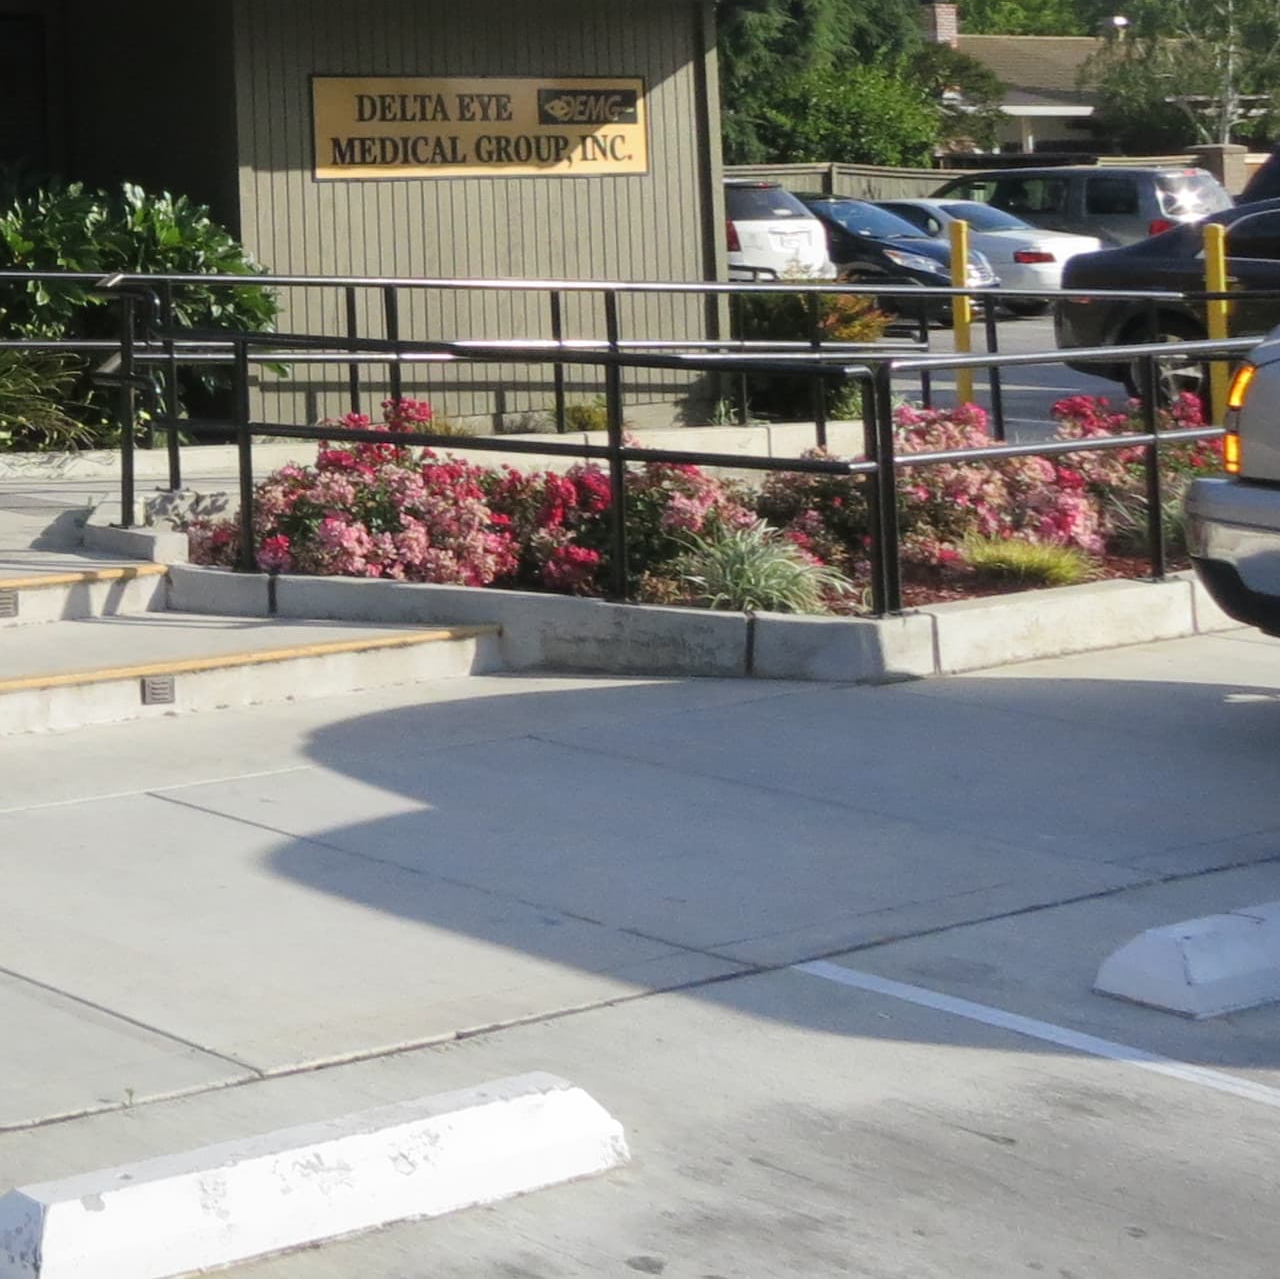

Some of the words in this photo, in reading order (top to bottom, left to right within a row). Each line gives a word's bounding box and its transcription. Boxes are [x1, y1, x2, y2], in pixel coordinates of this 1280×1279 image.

[354, 94, 451, 123] DELTA
[456, 94, 513, 122] EYE
[330, 135, 467, 165] MEDICAL
[474, 134, 573, 167] GROUP,
[579, 133, 634, 161] INC.
